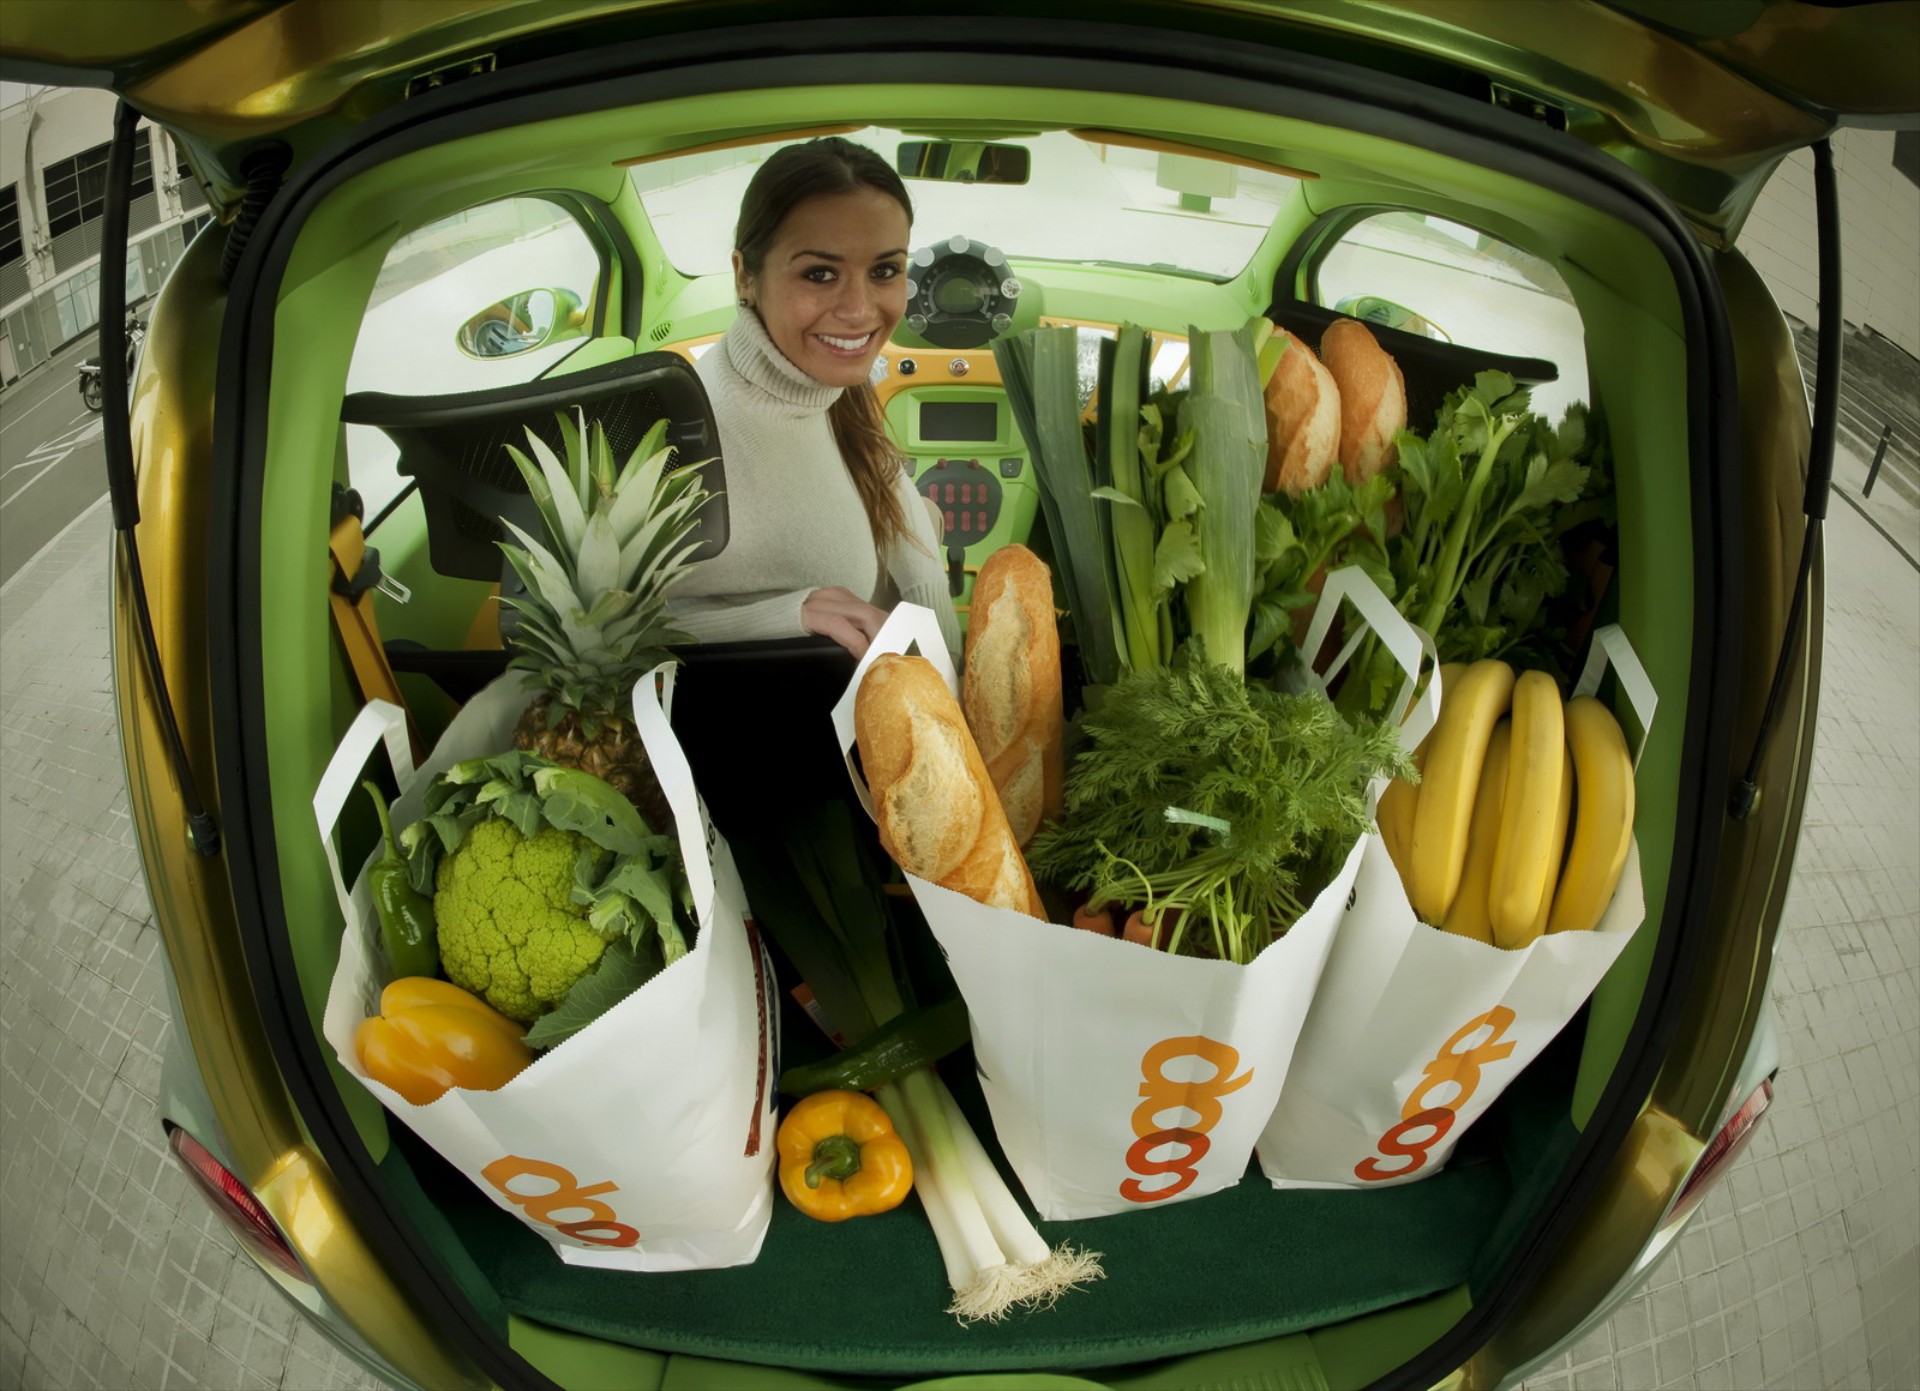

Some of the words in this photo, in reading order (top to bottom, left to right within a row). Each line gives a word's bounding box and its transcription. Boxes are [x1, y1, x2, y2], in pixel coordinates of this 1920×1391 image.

[1119, 1035, 1254, 1203] coop
[1354, 1005, 1517, 1181] coop
[480, 1155, 640, 1248] oop
